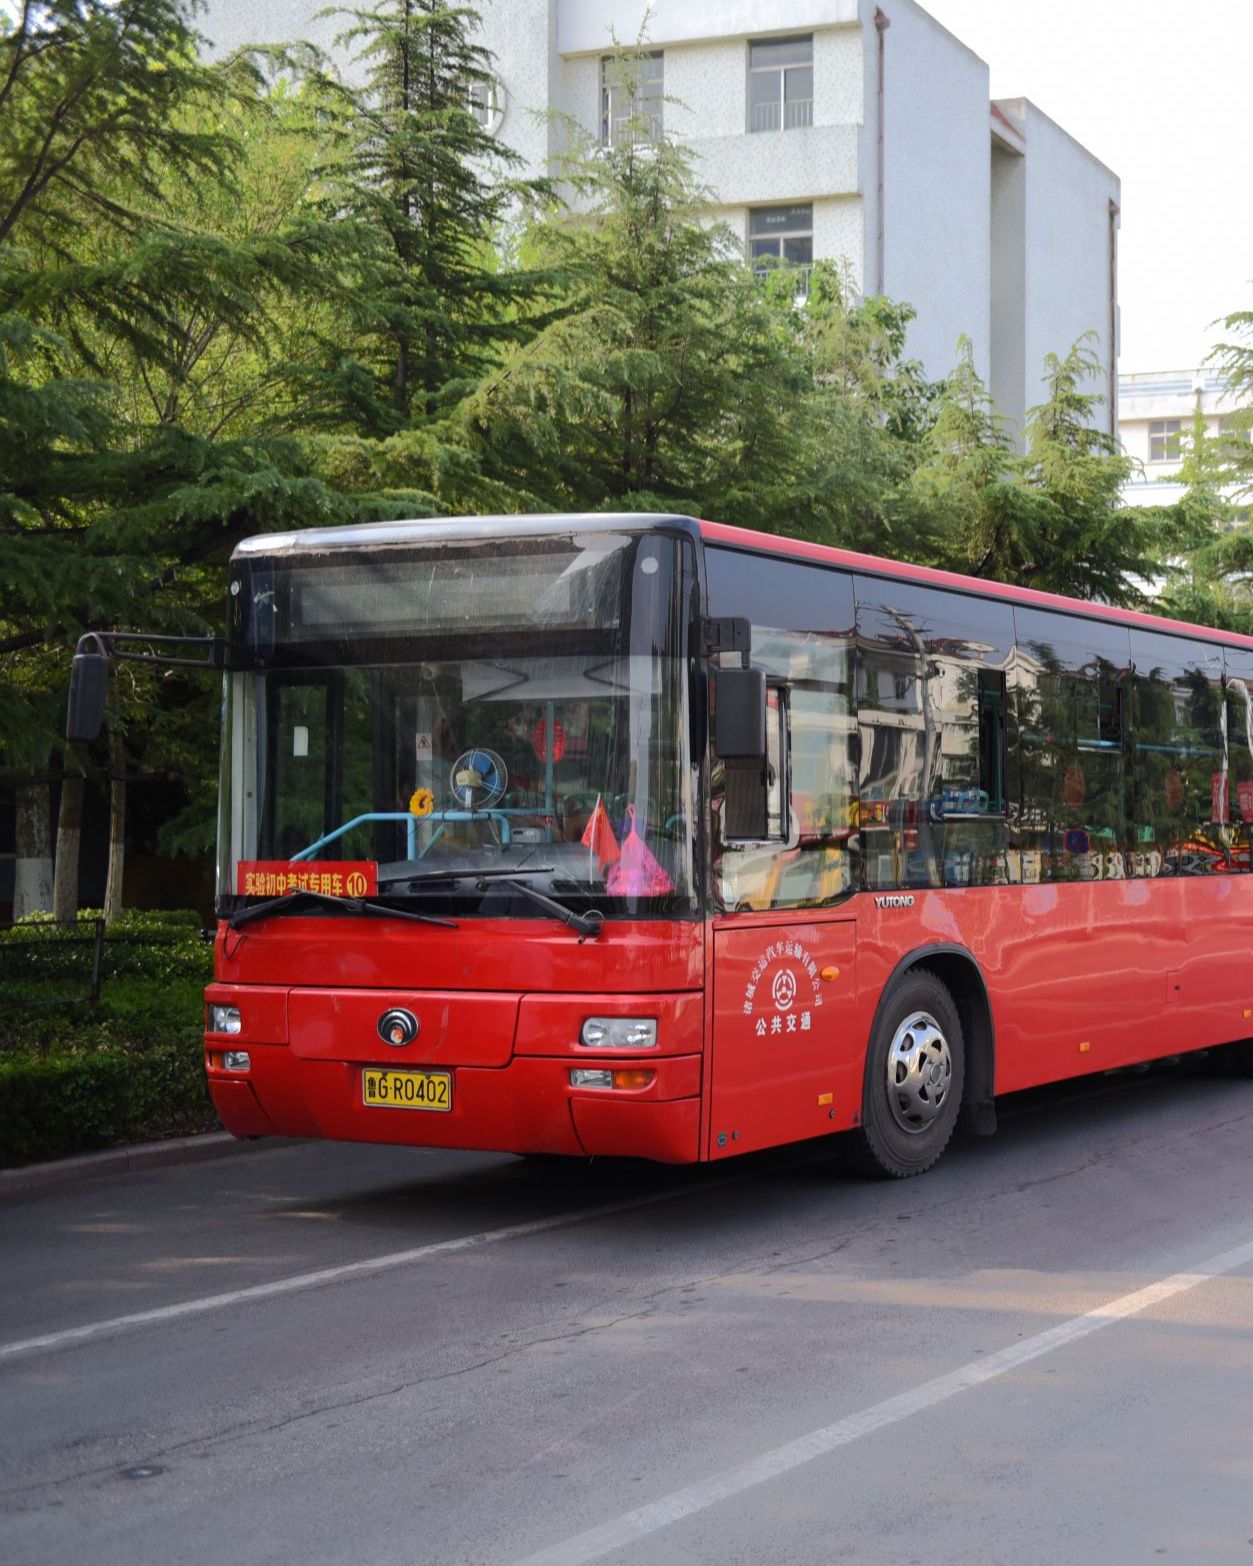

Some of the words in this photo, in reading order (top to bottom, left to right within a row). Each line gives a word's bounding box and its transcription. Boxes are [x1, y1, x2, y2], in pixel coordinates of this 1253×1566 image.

[245, 872, 343, 897] 实验初中考试专用车
[875, 895, 915, 909] YUTONG
[756, 1011, 812, 1037] 公共交通
